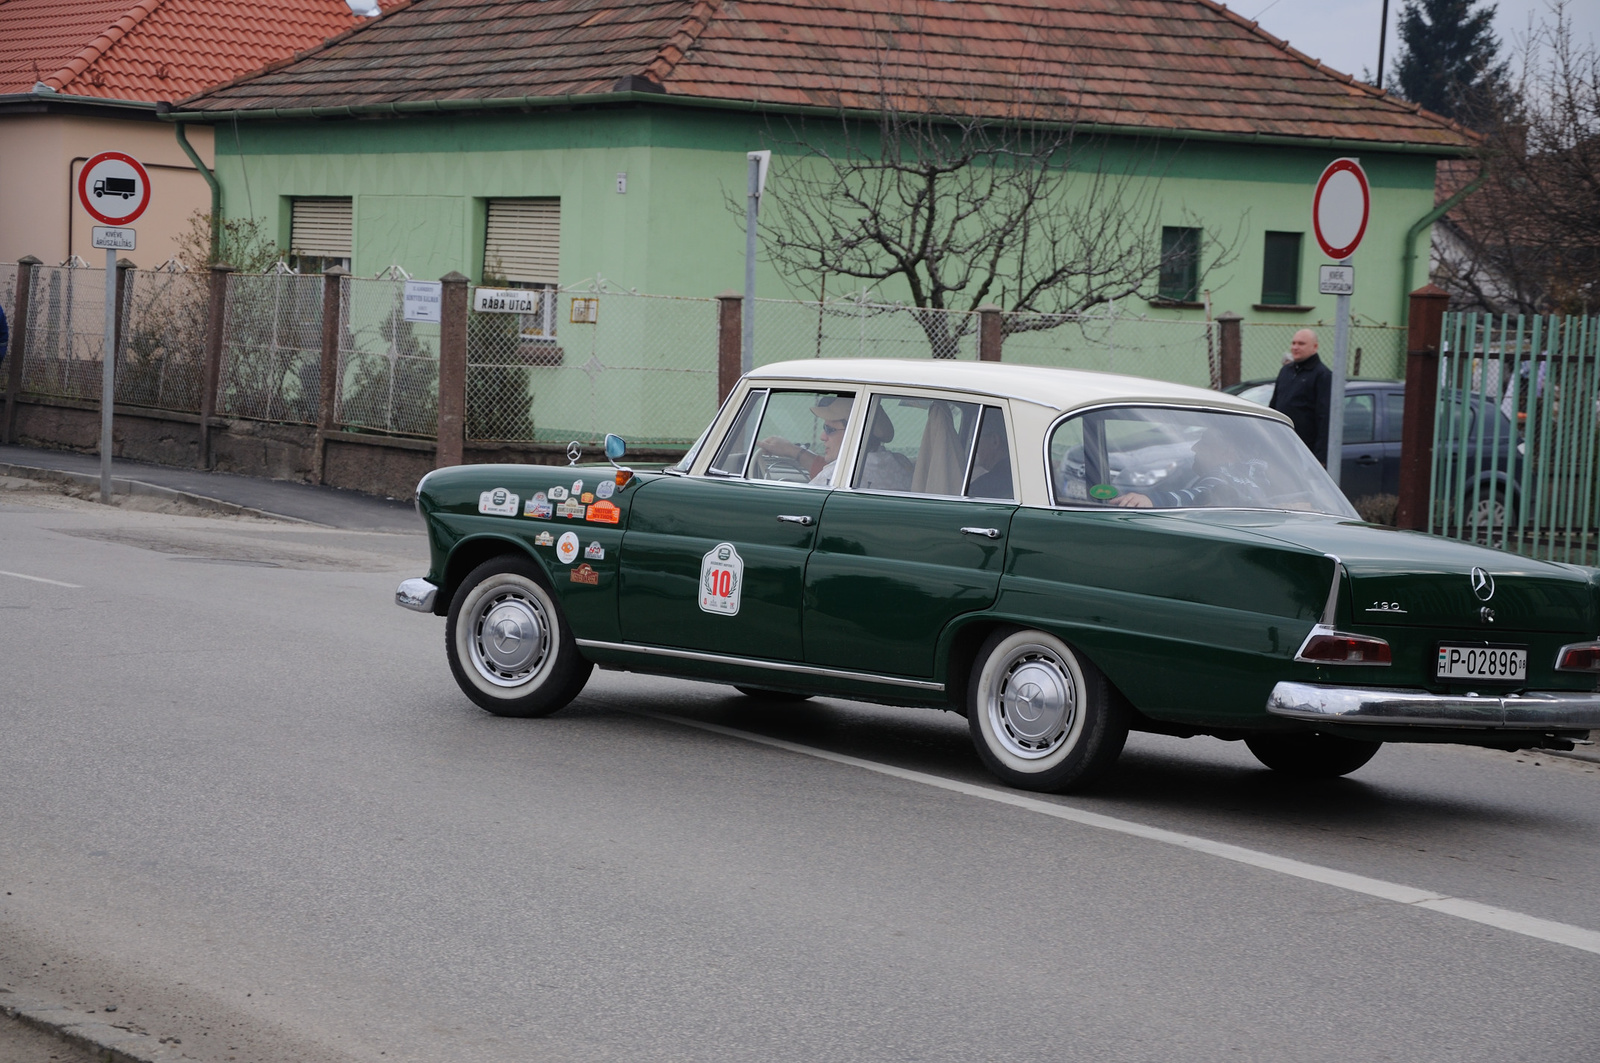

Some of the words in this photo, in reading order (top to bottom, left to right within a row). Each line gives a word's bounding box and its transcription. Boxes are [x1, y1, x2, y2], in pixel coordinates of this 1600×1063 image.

[105, 230, 123, 238] KIVÉVE
[482, 296, 505, 310] RÁBA
[509, 300, 531, 311] UTCA
[711, 569, 731, 597] 10
[1438, 662, 1446, 673] H
[1450, 650, 1518, 676] P-02896
